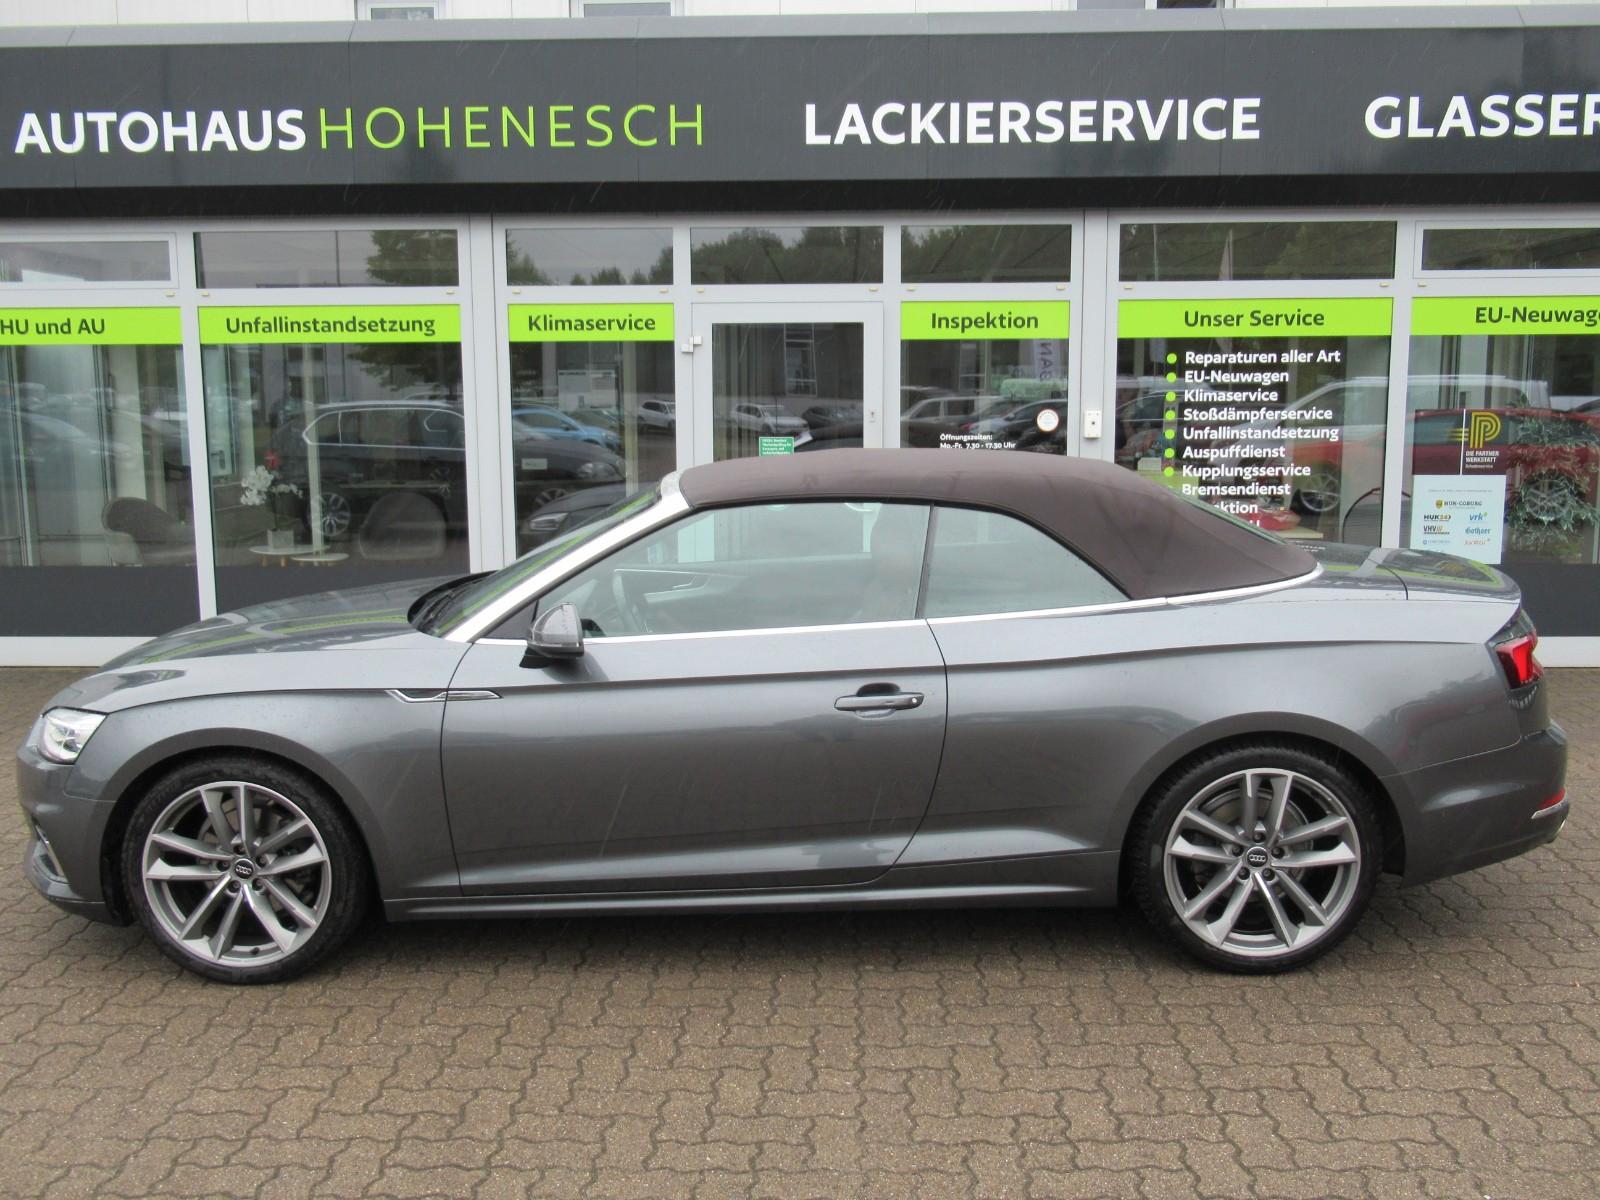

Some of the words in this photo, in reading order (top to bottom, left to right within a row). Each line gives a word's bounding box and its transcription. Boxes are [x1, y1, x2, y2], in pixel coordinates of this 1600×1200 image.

[15, 109, 306, 152] AUTOHAUS
[320, 104, 703, 149] HOHENESCH
[805, 98, 1261, 144] LACKIERSERVICE
[528, 314, 656, 331] Klimaservice
[931, 312, 1039, 333] Inspektion
[1184, 311, 1244, 327] Unser
[1250, 309, 1325, 326] Service
[1475, 306, 1600, 327] EU-Neuwag
[0, 319, 29, 335] HU
[36, 318, 71, 334] und
[78, 319, 105, 334] AU
[226, 316, 436, 336] Unfallinstandsetzung
[1185, 351, 1277, 366] Reparaturen
[1281, 350, 1313, 363] aller
[1316, 350, 1341, 362] Art
[1184, 370, 1289, 384] EU-Neuwagen
[1184, 388, 1278, 402] Klimaservice
[1183, 407, 1333, 422] Stoßdämpferservice
[940, 433, 993, 443] Öffnungszeiten:
[1183, 426, 1339, 441] Unfallinstandsetzung
[966, 442, 980, 450] 7.30
[985, 442, 1002, 450] 17.30
[1182, 446, 1286, 461] Auspuffdienst
[1182, 464, 1311, 479] Kupplungsservice
[1182, 483, 1291, 496] Bremsendienst
[1469, 512, 1485, 521] vrk
